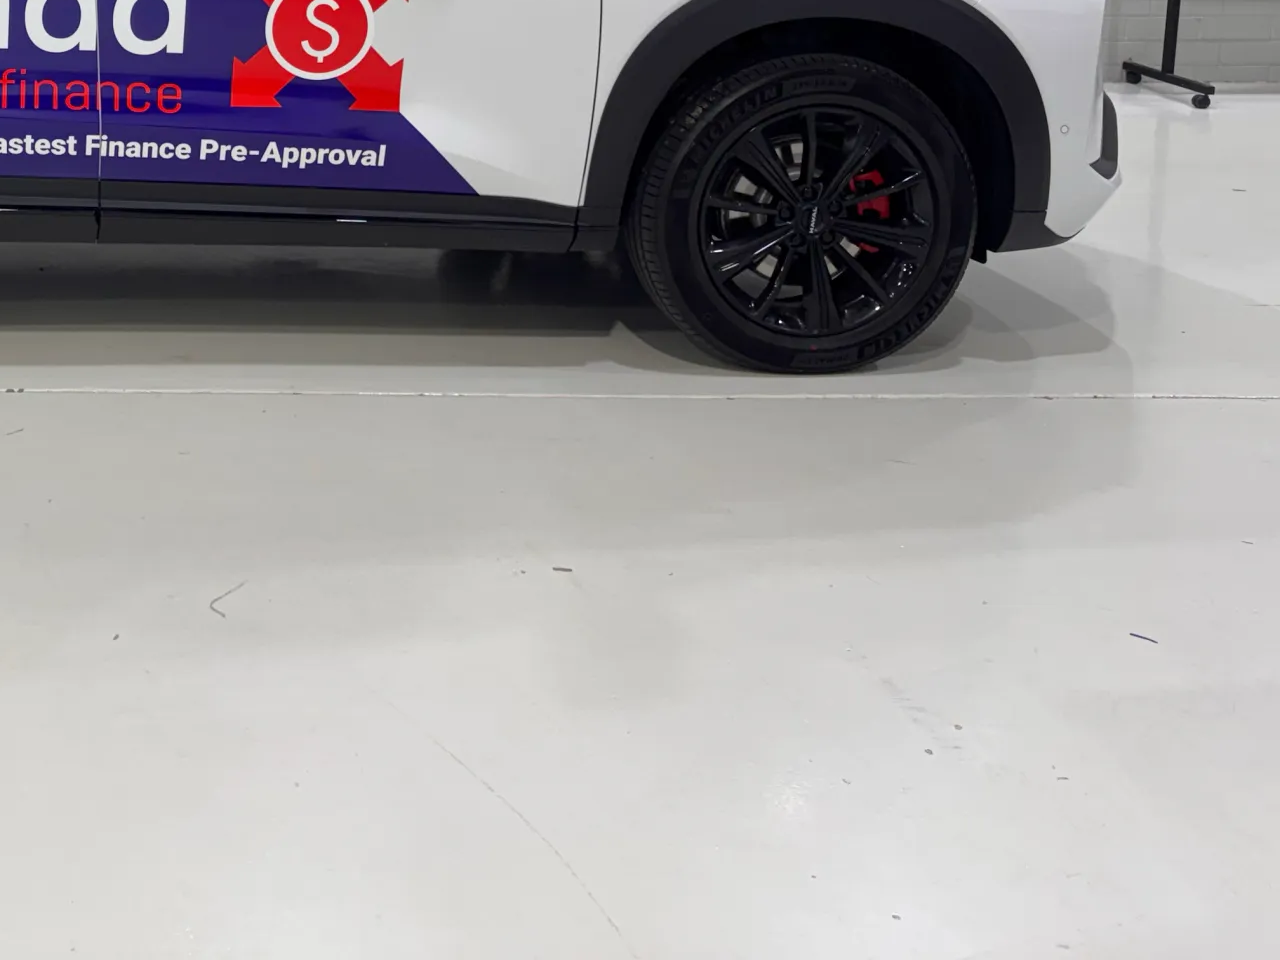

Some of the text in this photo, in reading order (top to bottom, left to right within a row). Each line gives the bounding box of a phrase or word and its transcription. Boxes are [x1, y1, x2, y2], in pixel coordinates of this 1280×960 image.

[85, 134, 192, 160] Finance
[199, 139, 388, 169] Pre-Approval
[808, 206, 818, 234] HAVAL
